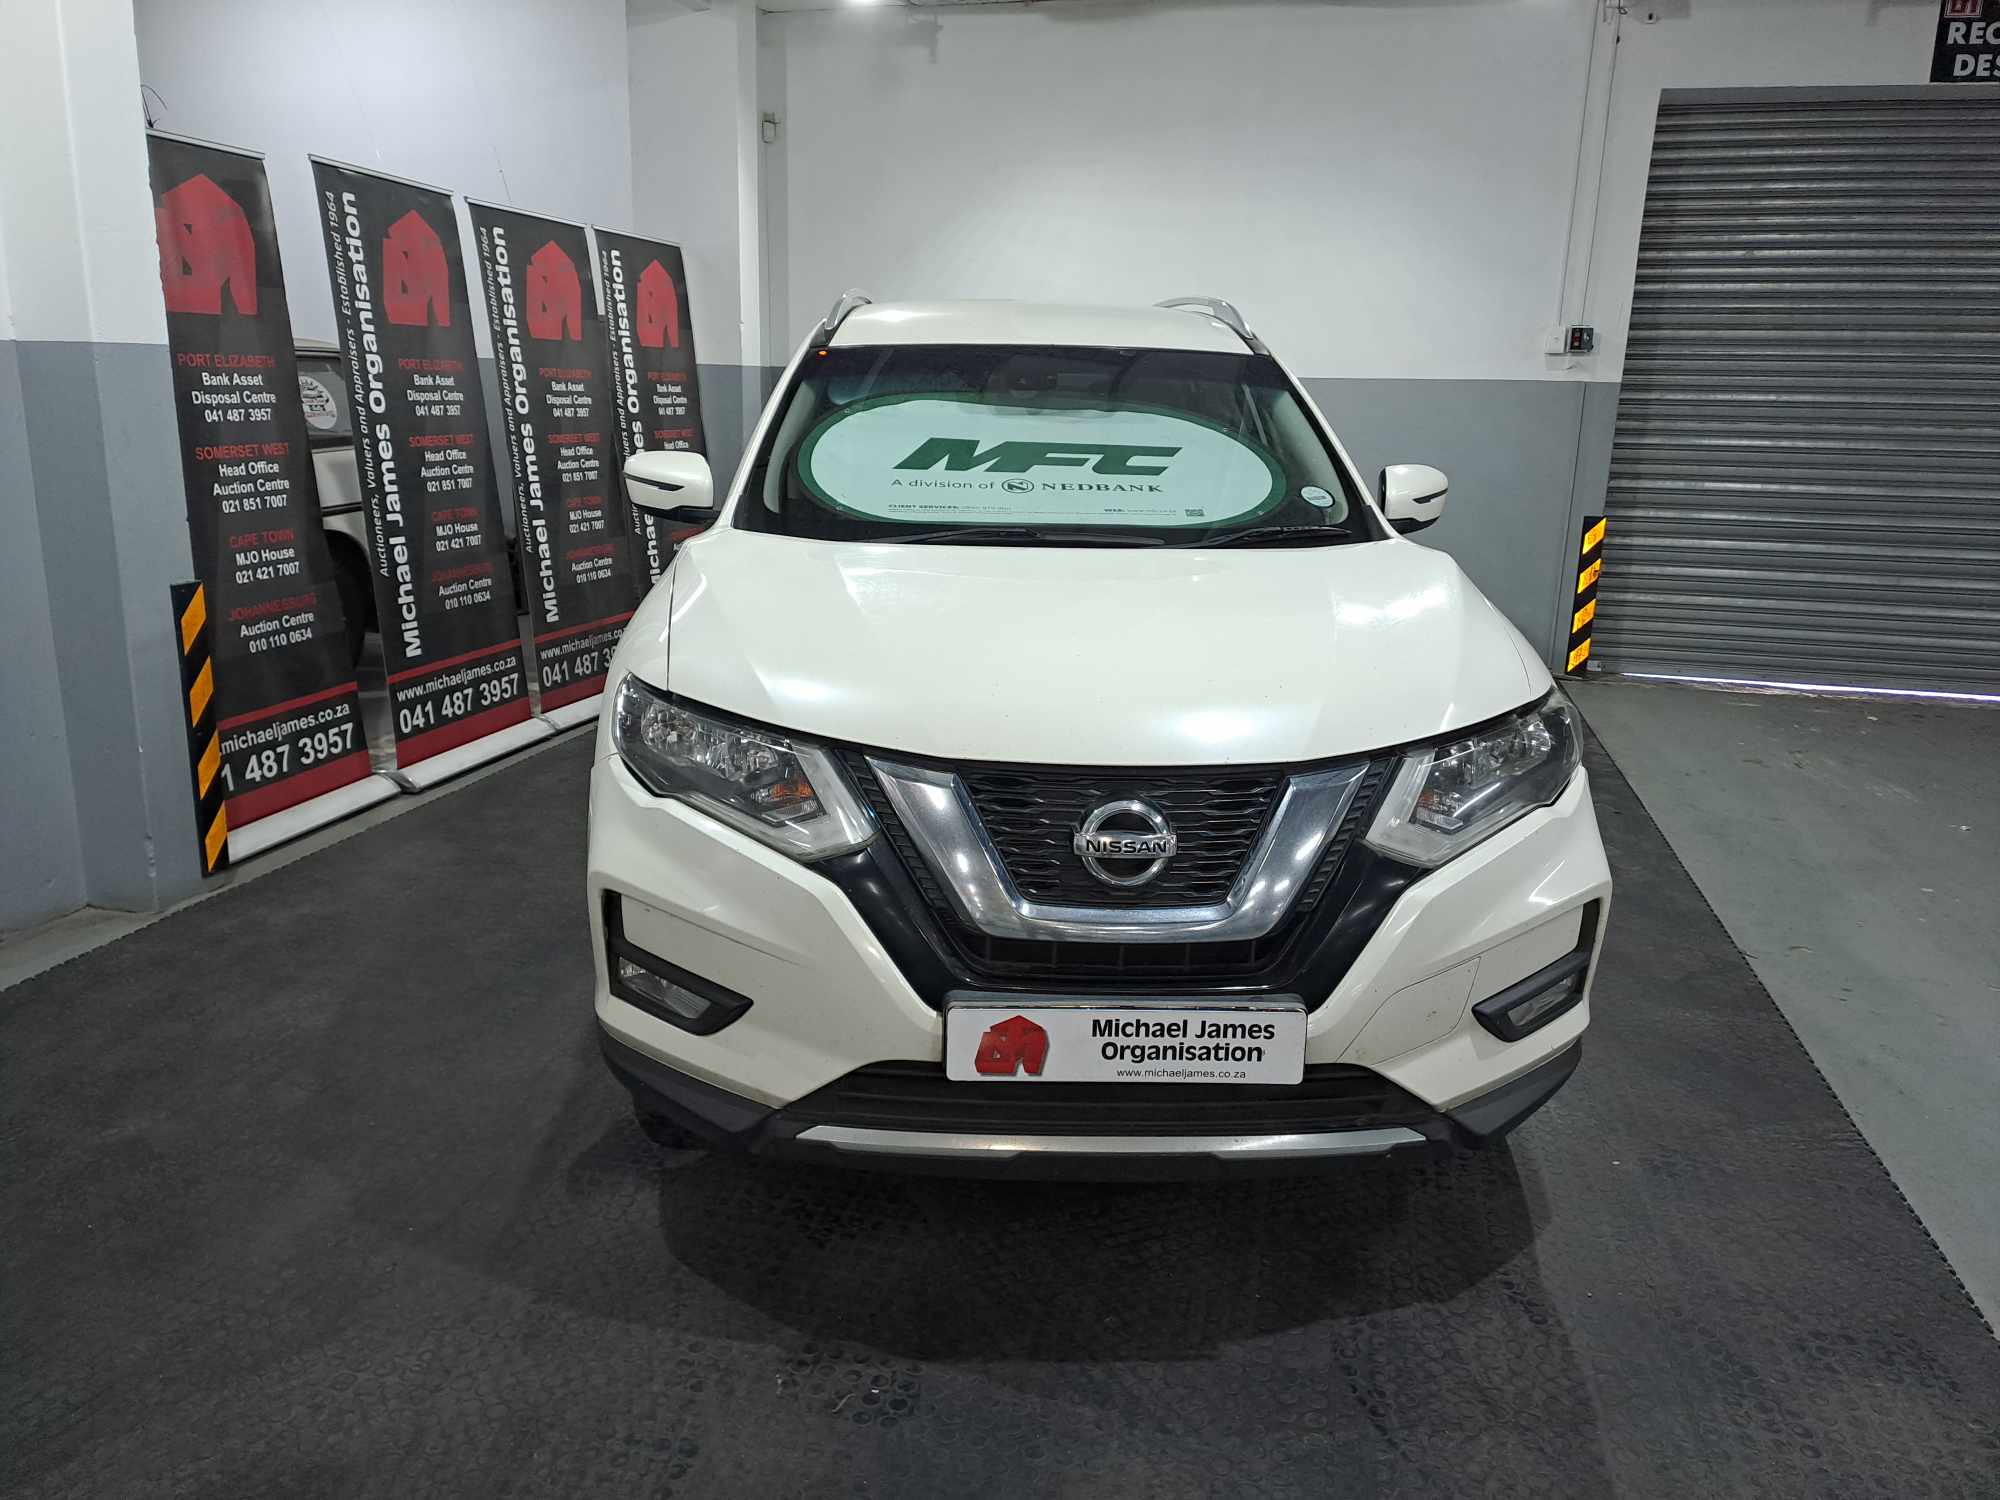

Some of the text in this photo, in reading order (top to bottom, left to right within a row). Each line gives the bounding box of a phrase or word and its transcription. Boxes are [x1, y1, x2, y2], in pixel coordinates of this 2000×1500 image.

[325, 190, 339, 228] 1964
[331, 231, 352, 316] Established
[610, 250, 640, 414] Organisation
[177, 352, 211, 368] PORT
[346, 327, 365, 403] Appraisers
[201, 372, 263, 386] Bank Asset
[413, 374, 455, 386] Bank Asset
[192, 390, 277, 407] Disposal Centre
[407, 389, 464, 403] Disposal Centre
[204, 407, 271, 423] 041 487 3957
[342, 191, 423, 659] Michael James Organisation
[355, 406, 368, 435] and
[493, 226, 560, 623] Michael James Organisation
[195, 444, 259, 461] SOMERSET
[424, 449, 467, 462] Head Office
[892, 437, 1184, 476] MFC
[218, 460, 279, 477] Head Office
[362, 437, 377, 490] Valuers
[420, 463, 474, 478] Auction Centre
[213, 478, 290, 496] Auction Centre
[890, 478, 1163, 493] A division of NEDBANK
[222, 494, 287, 513] 021 851 7007
[436, 522, 478, 537] MJO House
[235, 547, 295, 566] MJO House
[235, 561, 300, 584] 021 421 7007
[439, 578, 492, 597] Auction Centre
[240, 611, 314, 638] Auction Centre
[249, 626, 312, 653] 010 110 0634
[540, 628, 625, 660] www.michaeljames.co
[397, 656, 517, 702] www.michaeljames.co.za
[542, 660, 569, 687] 041
[574, 651, 599, 677] 487
[399, 672, 519, 734] 041 487 3957
[219, 703, 351, 757] .michaeljames.co.za
[244, 743, 290, 783] 487
[298, 721, 354, 765] 3957
[1086, 840, 1167, 853] NISSAN
[1091, 1019, 1275, 1040] Michael James
[1101, 1041, 1264, 1063] Organisation
[1116, 1068, 1246, 1079] www.michaeljames.co.za
